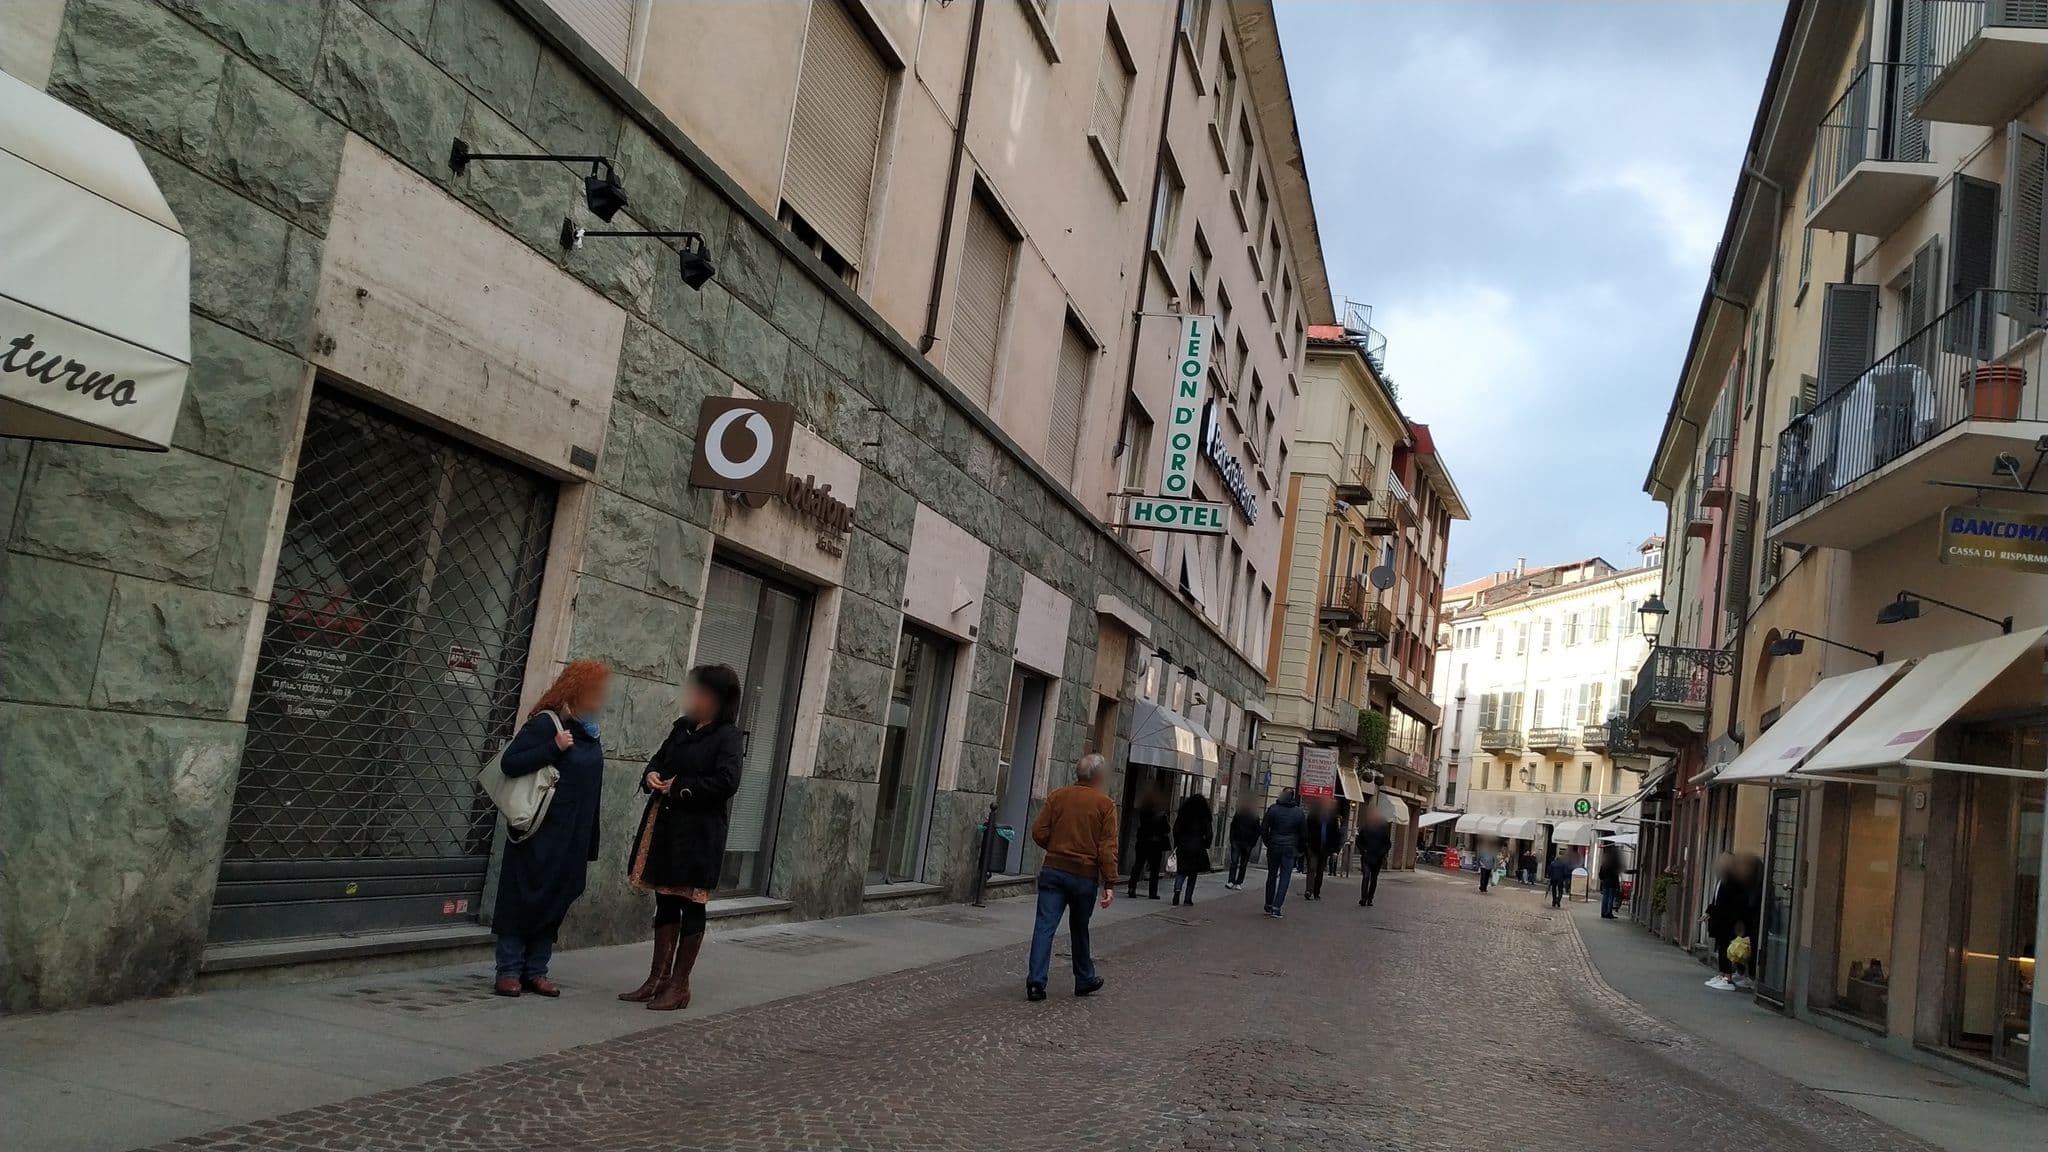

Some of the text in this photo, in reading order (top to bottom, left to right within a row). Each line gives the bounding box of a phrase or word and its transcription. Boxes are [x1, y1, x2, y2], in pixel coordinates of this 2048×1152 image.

[0, 333, 137, 407] turno
[1134, 502, 1222, 528] HOTEL
[1949, 546, 2048, 563] CASSA DI RISPARMI
